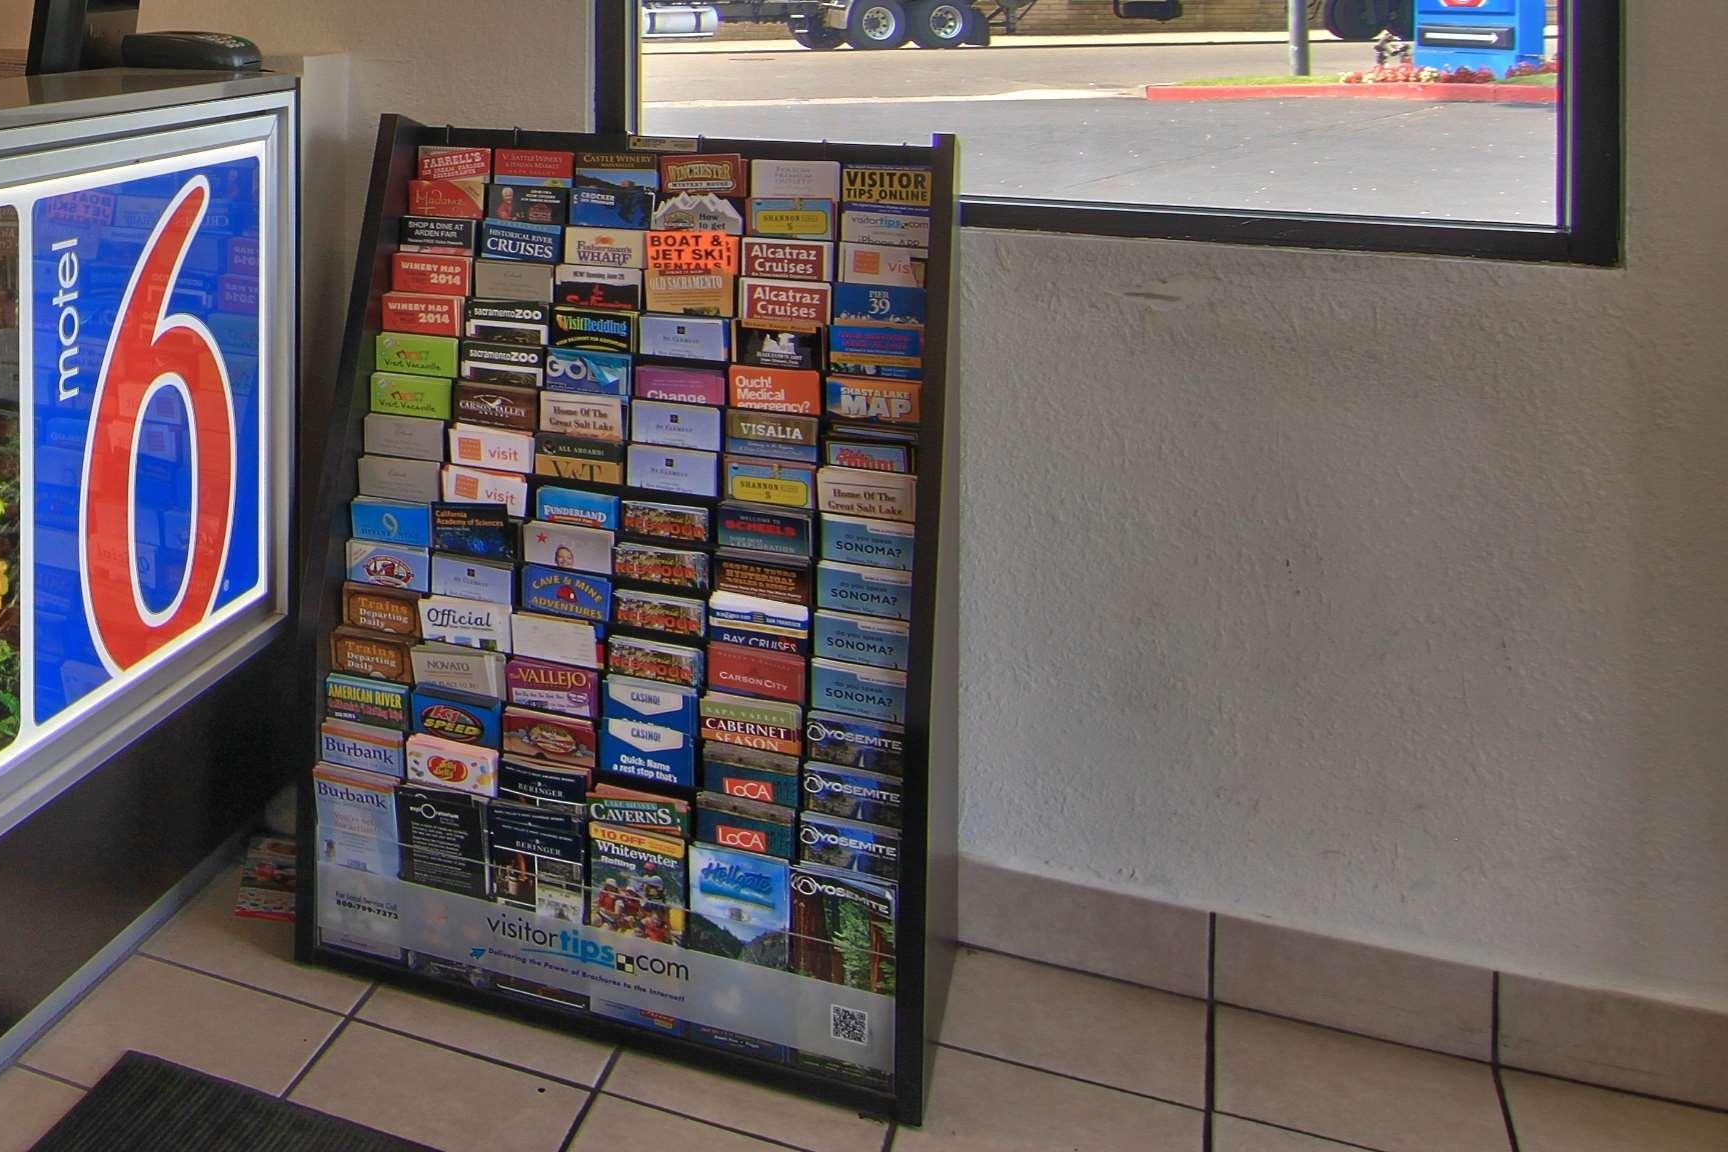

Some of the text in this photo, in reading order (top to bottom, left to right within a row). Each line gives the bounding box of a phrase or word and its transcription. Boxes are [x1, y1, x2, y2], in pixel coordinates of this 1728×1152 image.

[616, 154, 652, 164] WINERY
[846, 170, 927, 190] VISITOR
[846, 188, 928, 203] TIPS ONLINE
[698, 212, 720, 222] How
[489, 228, 528, 241] HISTORICAL
[650, 234, 722, 247] BOAT &
[486, 238, 553, 260] CRUISES
[576, 250, 632, 266] WHARF
[650, 249, 724, 262] JET SKI
[751, 244, 817, 260] Alcatraz
[400, 260, 462, 274] WINERY MAP
[754, 258, 814, 275] Cruises
[430, 273, 462, 286] 2014
[753, 286, 820, 305] Alcatraz
[869, 289, 890, 299] PIER
[388, 301, 449, 314] WINERY MAP
[756, 301, 816, 319] Cruises
[870, 298, 891, 315] 39
[52, 238, 80, 402] motel
[418, 311, 450, 325] 2014
[735, 375, 773, 389] Ouch!
[646, 390, 706, 405] Change
[735, 387, 785, 401] Medical
[839, 386, 912, 399] SHASTA LAKE
[553, 405, 608, 419] Home Of The
[840, 395, 913, 419] MAP
[78, 173, 238, 680] 6
[549, 416, 615, 432] Great Salt Lake
[740, 422, 804, 441] VISALIA
[487, 446, 520, 463] visit
[485, 488, 517, 507] visit
[832, 488, 897, 503] Home Of The
[543, 503, 608, 523] FUNDERLAND
[828, 500, 903, 516] Great Salt Lake
[835, 540, 902, 559] SONOMA?
[532, 575, 604, 603] CAVE MINE
[830, 588, 898, 606] SONOMA?
[359, 607, 410, 625] Departing
[427, 607, 493, 628] Official
[532, 596, 604, 621] ADVENTURES
[359, 617, 384, 629] Daily
[826, 636, 895, 656] SONOMA?
[346, 651, 397, 668] Departing
[426, 659, 470, 672] NOVATO
[517, 667, 587, 689] VALLEJO
[328, 683, 374, 706] AMERICAN
[375, 690, 403, 710] RIVER
[825, 688, 893, 708] SONOMA?
[423, 717, 483, 736] SPEED
[630, 727, 662, 743] CASINO!
[705, 717, 788, 740] CABERNET
[715, 731, 779, 752] SEASON
[823, 727, 903, 751] YOSEMITE
[325, 735, 394, 766] Burbank
[317, 781, 387, 809] Burbank
[822, 779, 901, 803] YOSEMITE
[590, 802, 672, 826] CAVERNS
[619, 831, 648, 847] OFF
[819, 832, 898, 857] YOSEMITE
[596, 839, 679, 869] Whitewater
[700, 860, 773, 892] Hellgate
[816, 883, 890, 914] YOSEMITE
[528, 956, 542, 966] the
[543, 960, 569, 974] Power
[570, 968, 580, 978] of
[581, 970, 622, 987] Brochures
[623, 981, 632, 990] to
[634, 983, 648, 994] the
